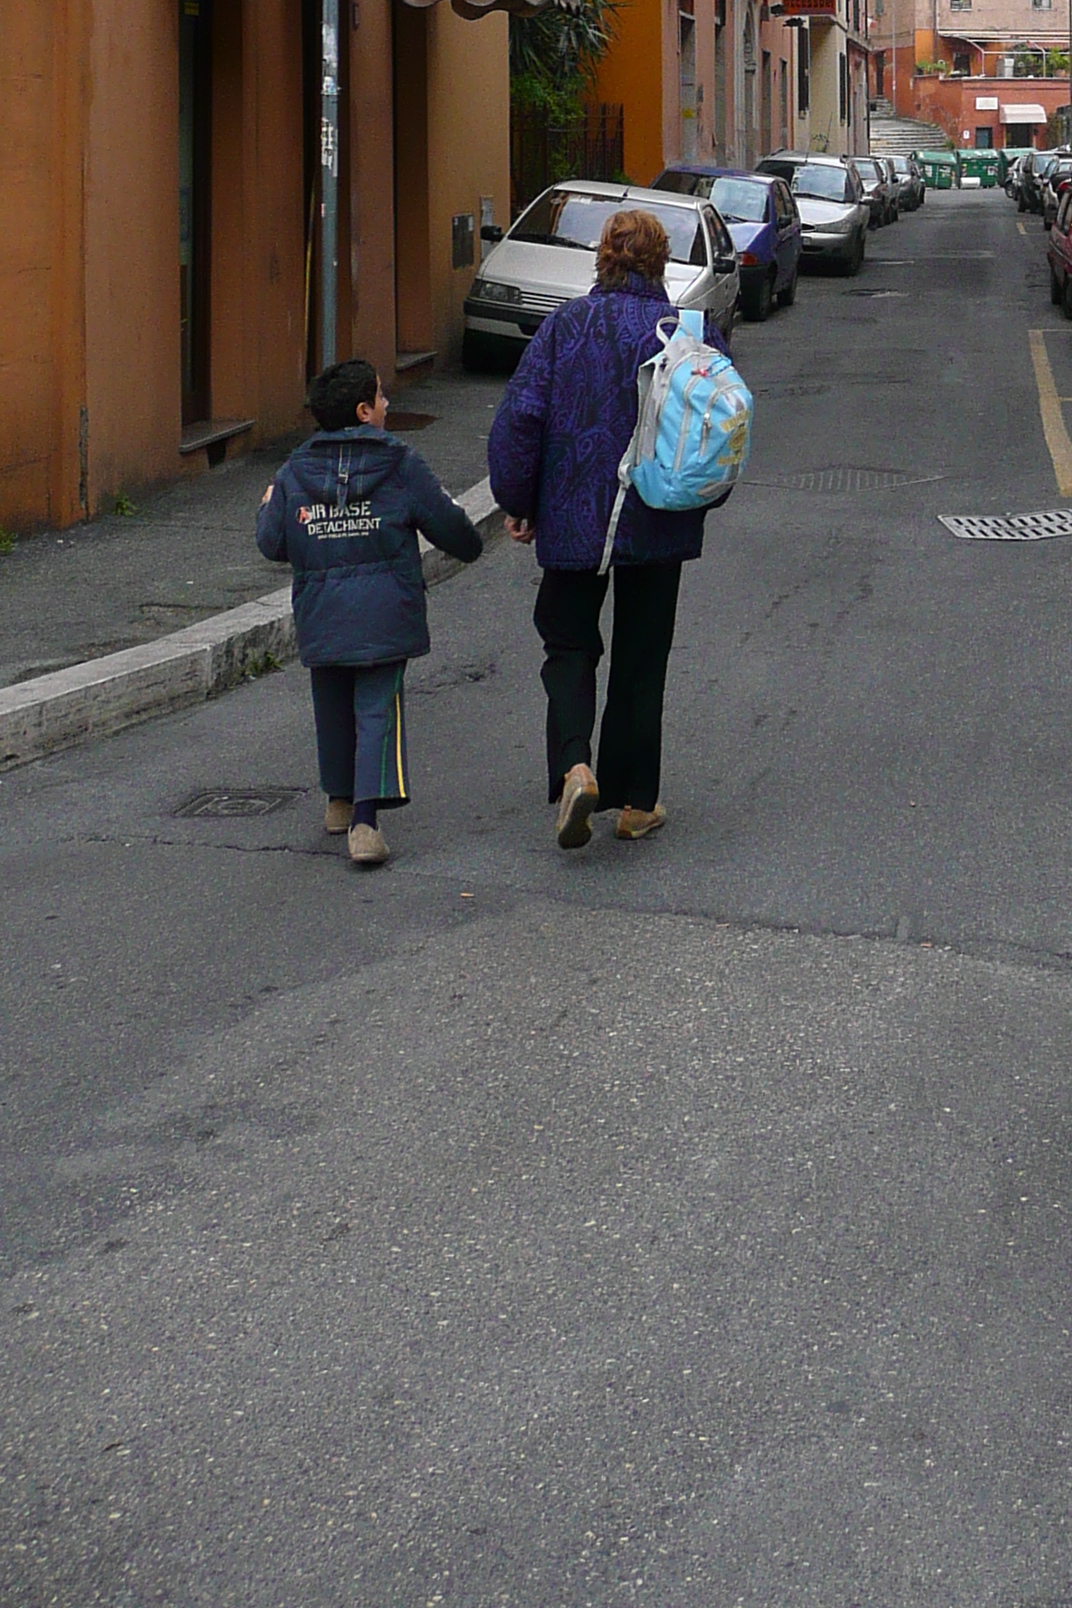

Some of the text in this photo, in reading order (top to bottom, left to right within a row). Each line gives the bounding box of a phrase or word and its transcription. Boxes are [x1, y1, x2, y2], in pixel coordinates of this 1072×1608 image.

[298, 500, 371, 524] AIR BASE
[307, 517, 381, 536] DETACHMENT
